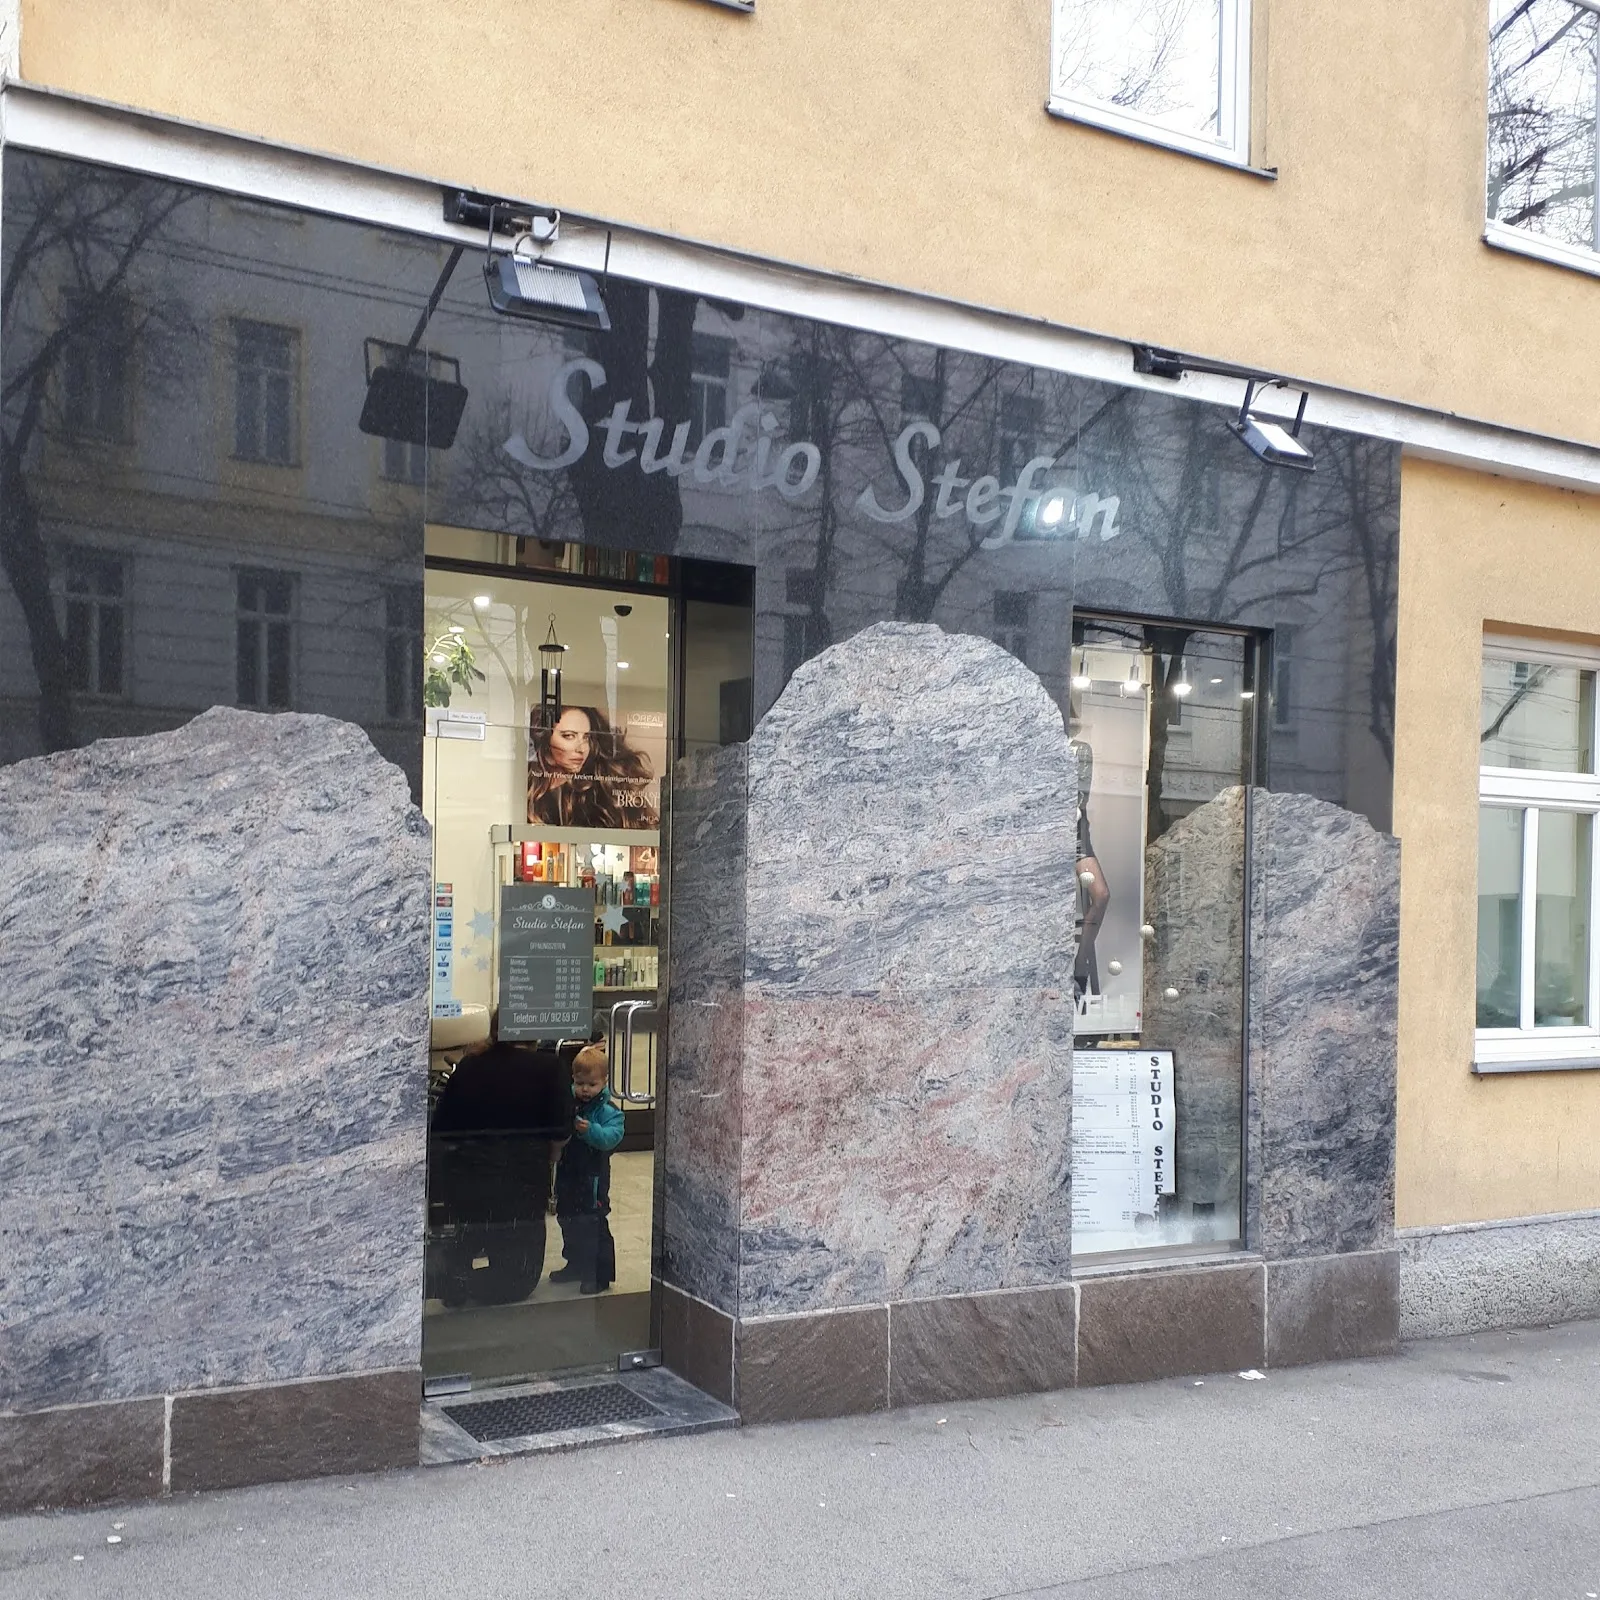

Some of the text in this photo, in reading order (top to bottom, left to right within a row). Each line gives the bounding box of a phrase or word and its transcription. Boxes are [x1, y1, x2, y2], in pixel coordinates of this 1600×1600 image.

[503, 357, 1120, 549] Studio Stefan
[513, 916, 586, 934] Studio Stefan
[1150, 1056, 1164, 1131] STUDIO
